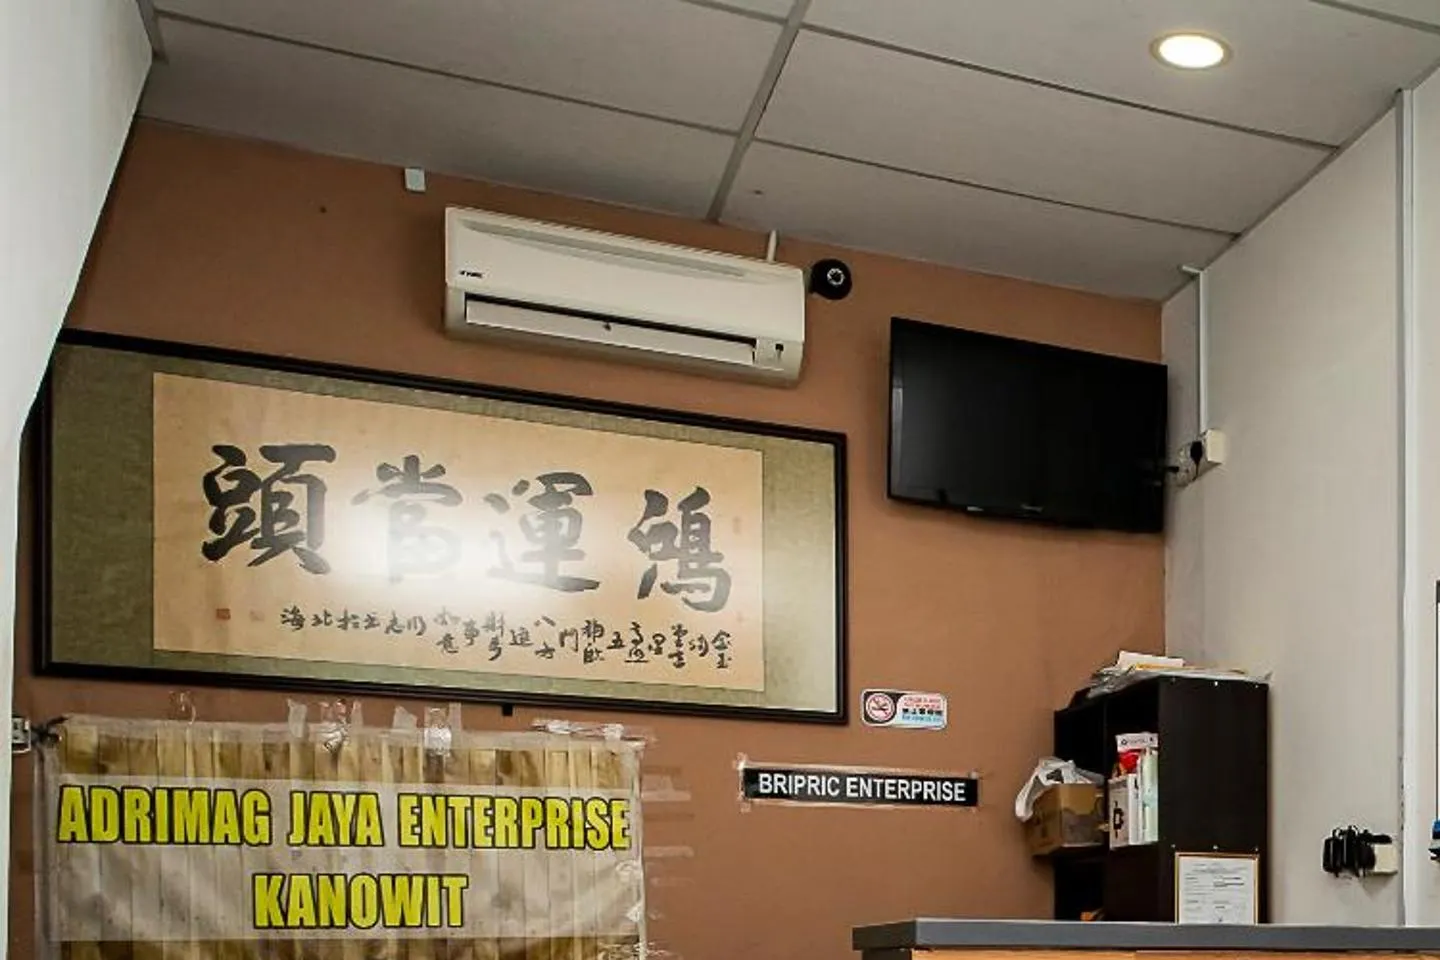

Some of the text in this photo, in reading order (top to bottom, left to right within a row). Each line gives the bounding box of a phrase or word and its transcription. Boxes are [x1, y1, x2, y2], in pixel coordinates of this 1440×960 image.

[758, 773, 967, 802] BRIPRIC ENTERPRISE
[57, 785, 632, 850] ADRIMAG JAYA ENTERPRISE
[253, 874, 469, 930] KANOWIT
